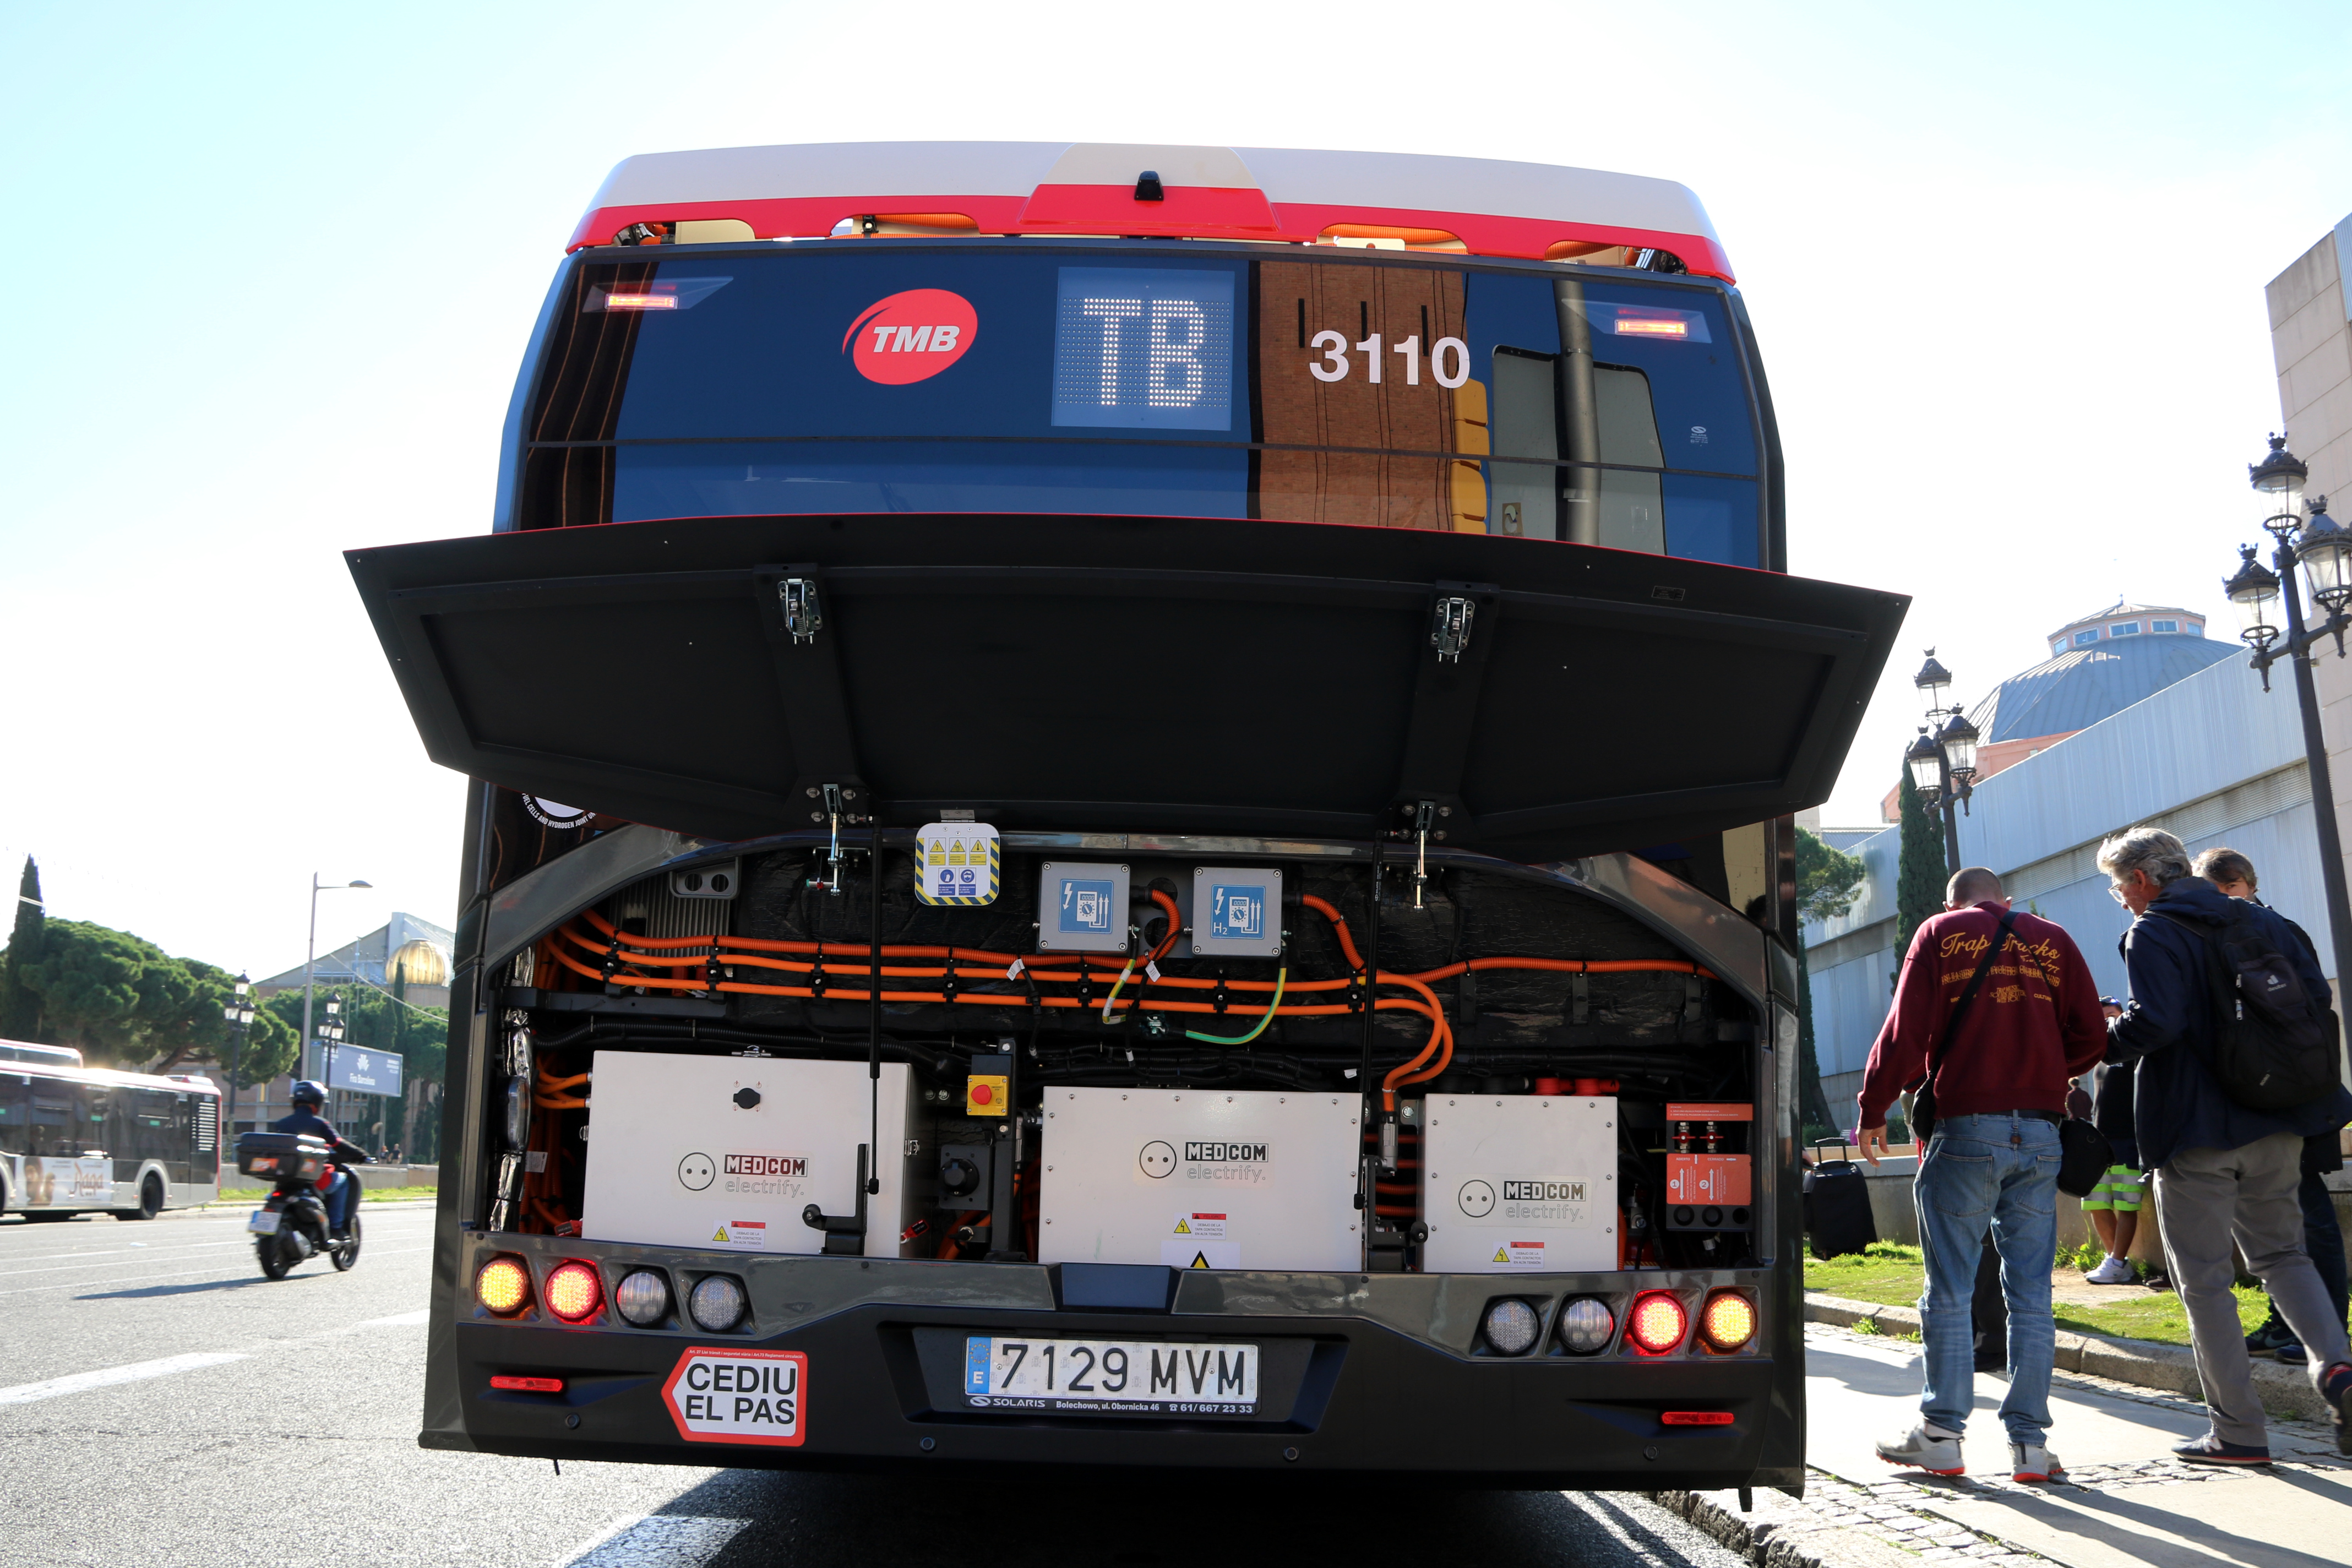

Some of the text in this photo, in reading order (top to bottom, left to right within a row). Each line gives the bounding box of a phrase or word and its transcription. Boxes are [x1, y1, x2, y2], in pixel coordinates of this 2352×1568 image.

[873, 325, 960, 352] TMB
[1083, 298, 1204, 407] TB
[1309, 330, 1471, 389] 3110
[527, 804, 540, 818] CELLS
[537, 815, 548, 825] AND
[548, 820, 575, 829] HYDROGEN
[575, 815, 589, 826] JOINT
[1940, 932, 1991, 959] Trap
[1187, 1143, 1266, 1161] MEDCOM
[726, 1156, 806, 1175] MEDCOM
[1187, 1164, 1266, 1183] electrify.
[725, 1177, 804, 1197] electrify.
[1506, 1182, 1584, 1200] MEDCOM
[1506, 1203, 1583, 1222] electrify.
[687, 1363, 796, 1395] CEDIU
[973, 1371, 984, 1384] E
[1001, 1344, 1244, 1395] 7129 MVM
[685, 1395, 795, 1424] EL PAS
[993, 1398, 1046, 1407] SOLARIS
[1056, 1401, 1100, 1411] Bolechowo,
[1112, 1402, 1148, 1411] Obornicka
